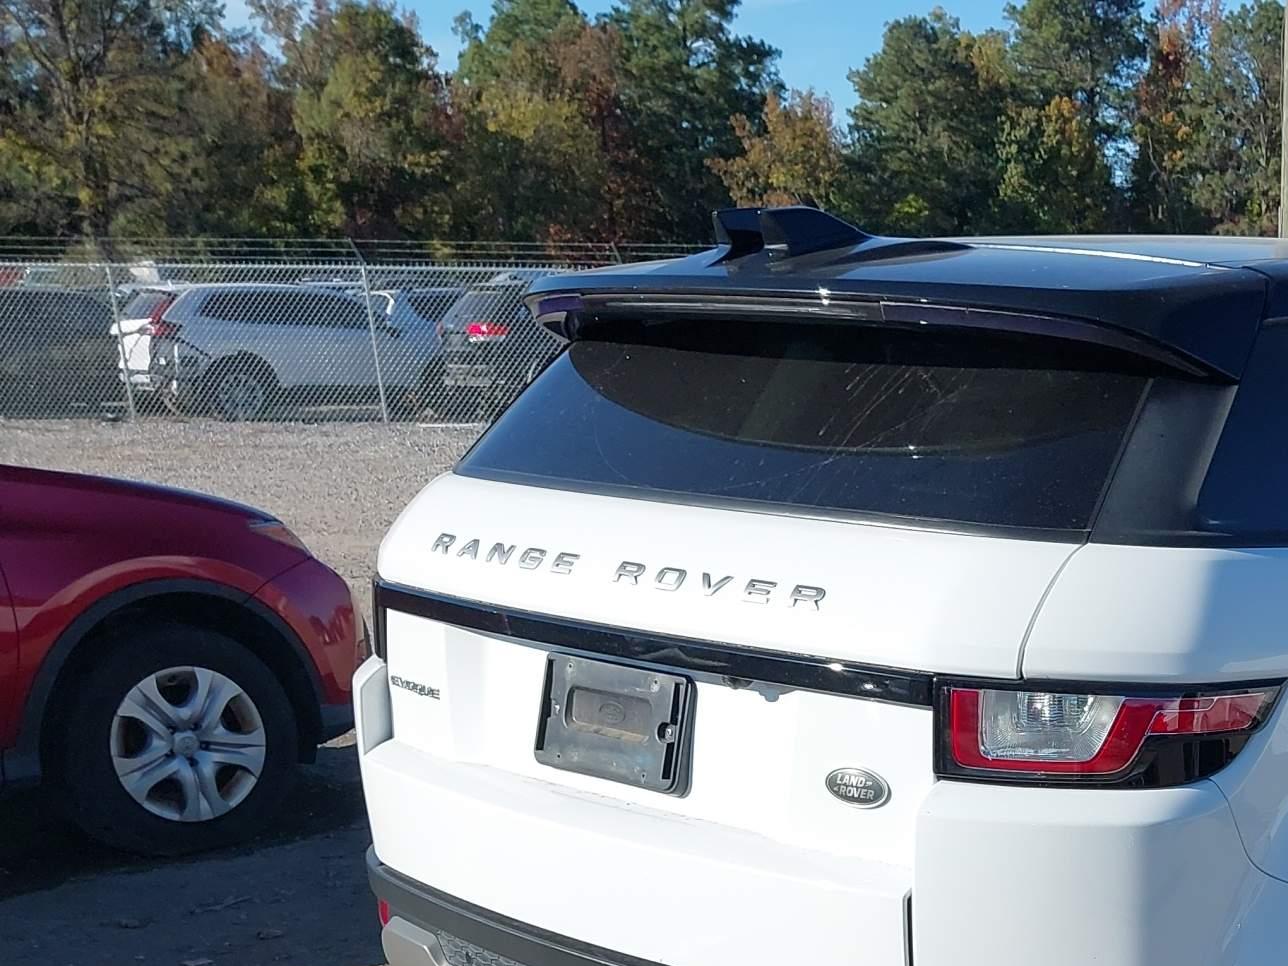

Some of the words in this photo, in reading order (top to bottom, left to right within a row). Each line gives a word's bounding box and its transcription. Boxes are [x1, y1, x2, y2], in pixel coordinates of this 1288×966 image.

[431, 532, 580, 575] RANGE
[613, 561, 826, 611] ROVER
[836, 773, 866, 788] LAND
[838, 785, 875, 800] ROVER
